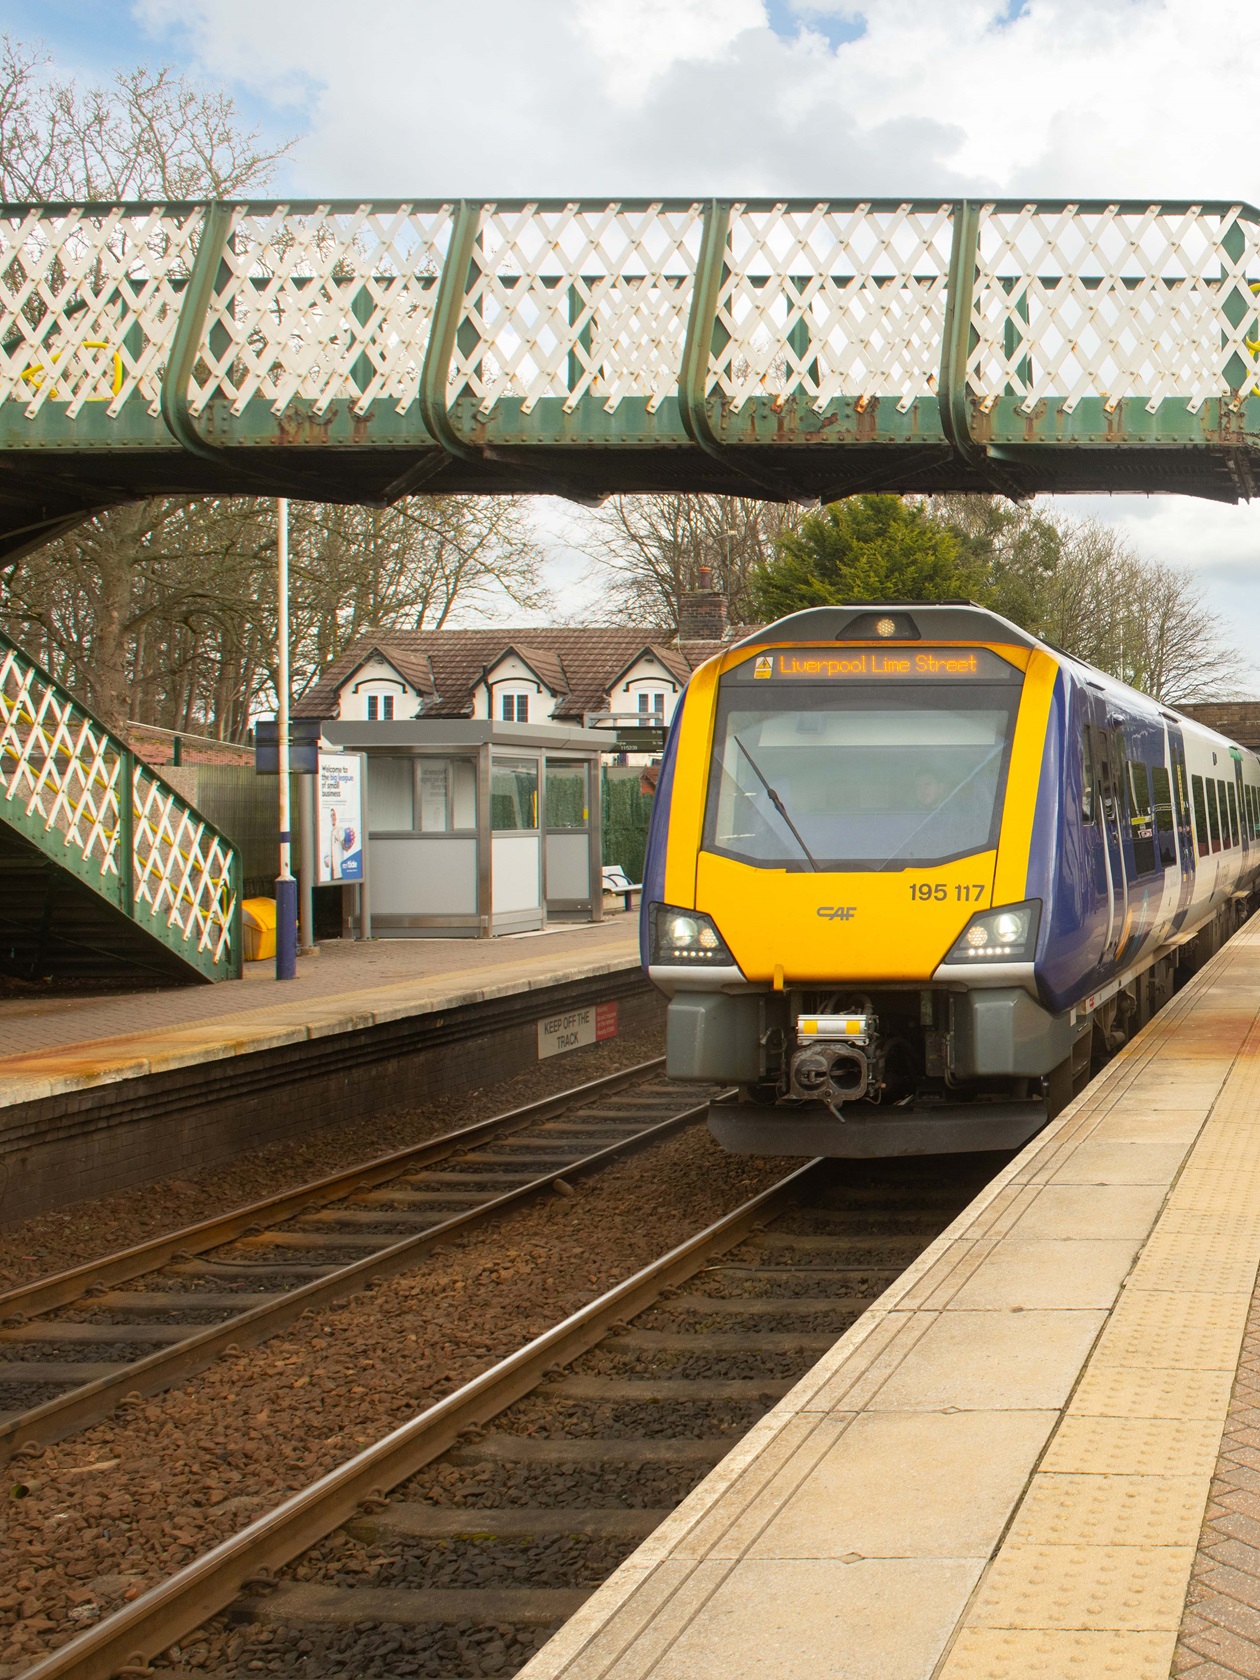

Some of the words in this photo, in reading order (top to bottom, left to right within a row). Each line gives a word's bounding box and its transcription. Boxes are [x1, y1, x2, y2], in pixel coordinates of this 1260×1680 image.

[779, 655, 866, 675] Liverpool
[871, 655, 910, 673] Lime
[915, 654, 977, 673] Street
[321, 764, 342, 773] Welcome
[321, 773, 329, 781] the
[330, 774, 338, 784] big
[338, 774, 354, 784] league
[321, 781, 327, 789] of
[327, 781, 340, 789] small
[909, 883, 948, 901] 195
[954, 884, 986, 902] 117
[816, 906, 857, 921] CAF
[544, 1018, 562, 1035] KEEP
[563, 1014, 577, 1030] OFF
[577, 1011, 590, 1026] THE
[556, 1031, 579, 1049] TRACK
